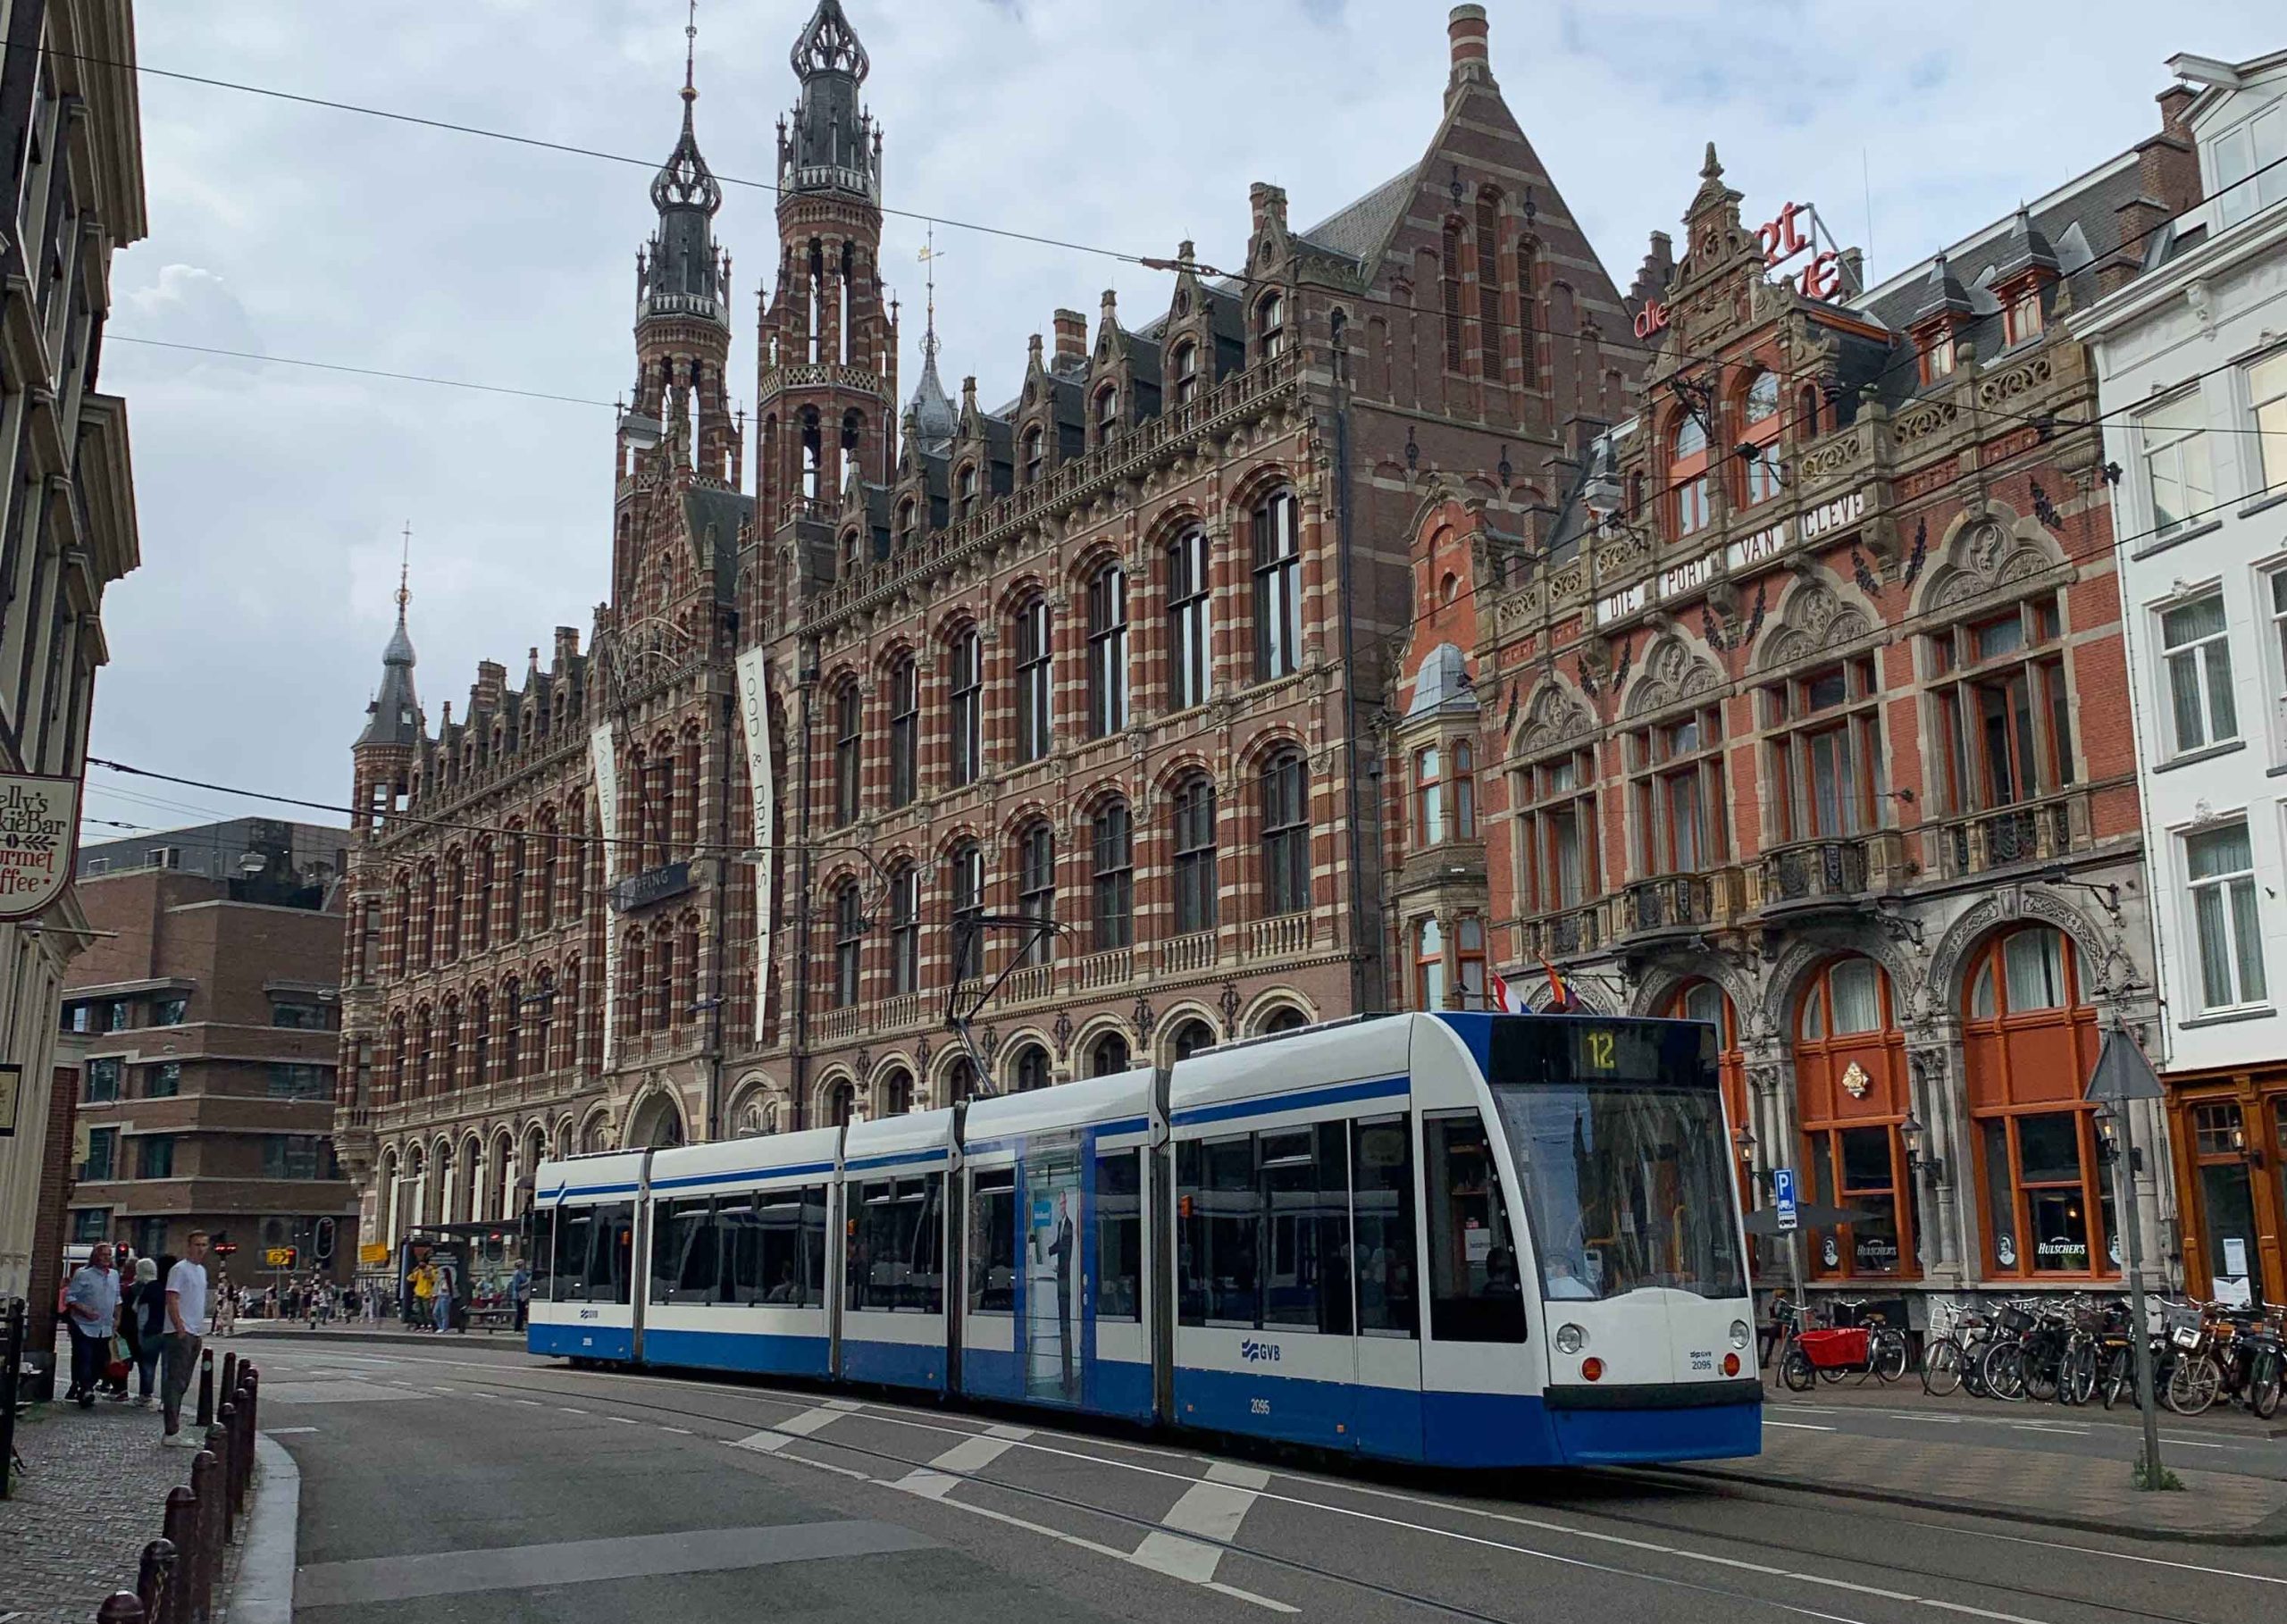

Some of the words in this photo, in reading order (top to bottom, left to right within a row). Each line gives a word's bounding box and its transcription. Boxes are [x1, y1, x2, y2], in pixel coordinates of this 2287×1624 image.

[1611, 589, 1635, 618] DIE
[1667, 561, 1706, 596] PORT
[1742, 526, 1774, 564] VAN
[746, 662, 759, 737] FOOD
[753, 753, 762, 766] &
[599, 735, 613, 833] FASHION
[1587, 1032, 1615, 1069] 12
[1778, 1173, 1789, 1195] P
[2038, 1243, 2085, 1255] HULSCHER'S
[1260, 1344, 1280, 1361] GVB
[1692, 1360, 1712, 1370] 2095
[1251, 1398, 1270, 1415] 2095
